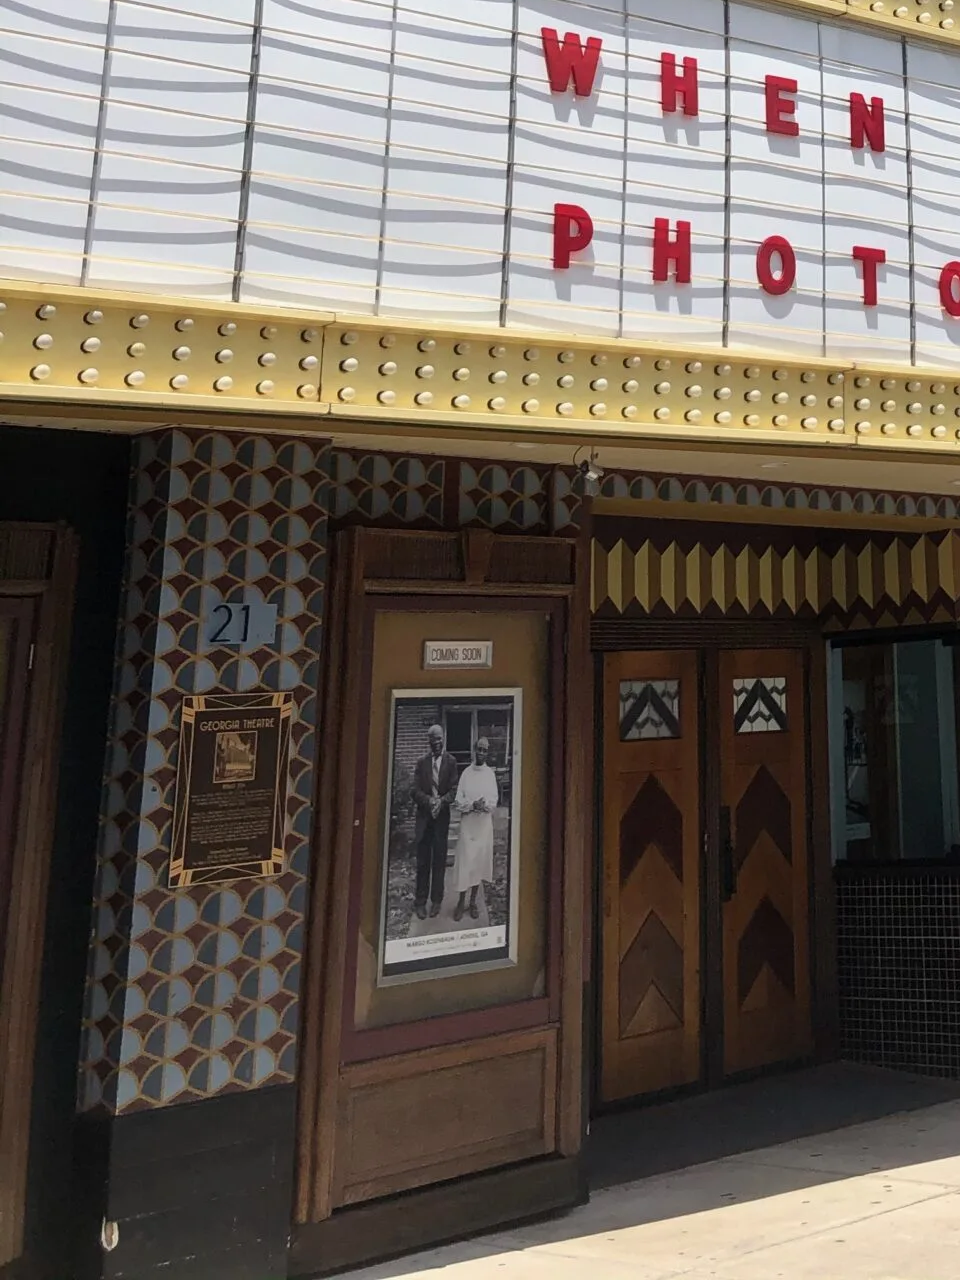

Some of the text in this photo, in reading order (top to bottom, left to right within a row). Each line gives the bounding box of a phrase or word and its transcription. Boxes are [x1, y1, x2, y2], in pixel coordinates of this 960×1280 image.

[540, 26, 886, 153] WHEN
[209, 604, 251, 642] 21
[431, 648, 482, 661] COMING SOON
[199, 717, 275, 732] GEORGIA THEATRE
